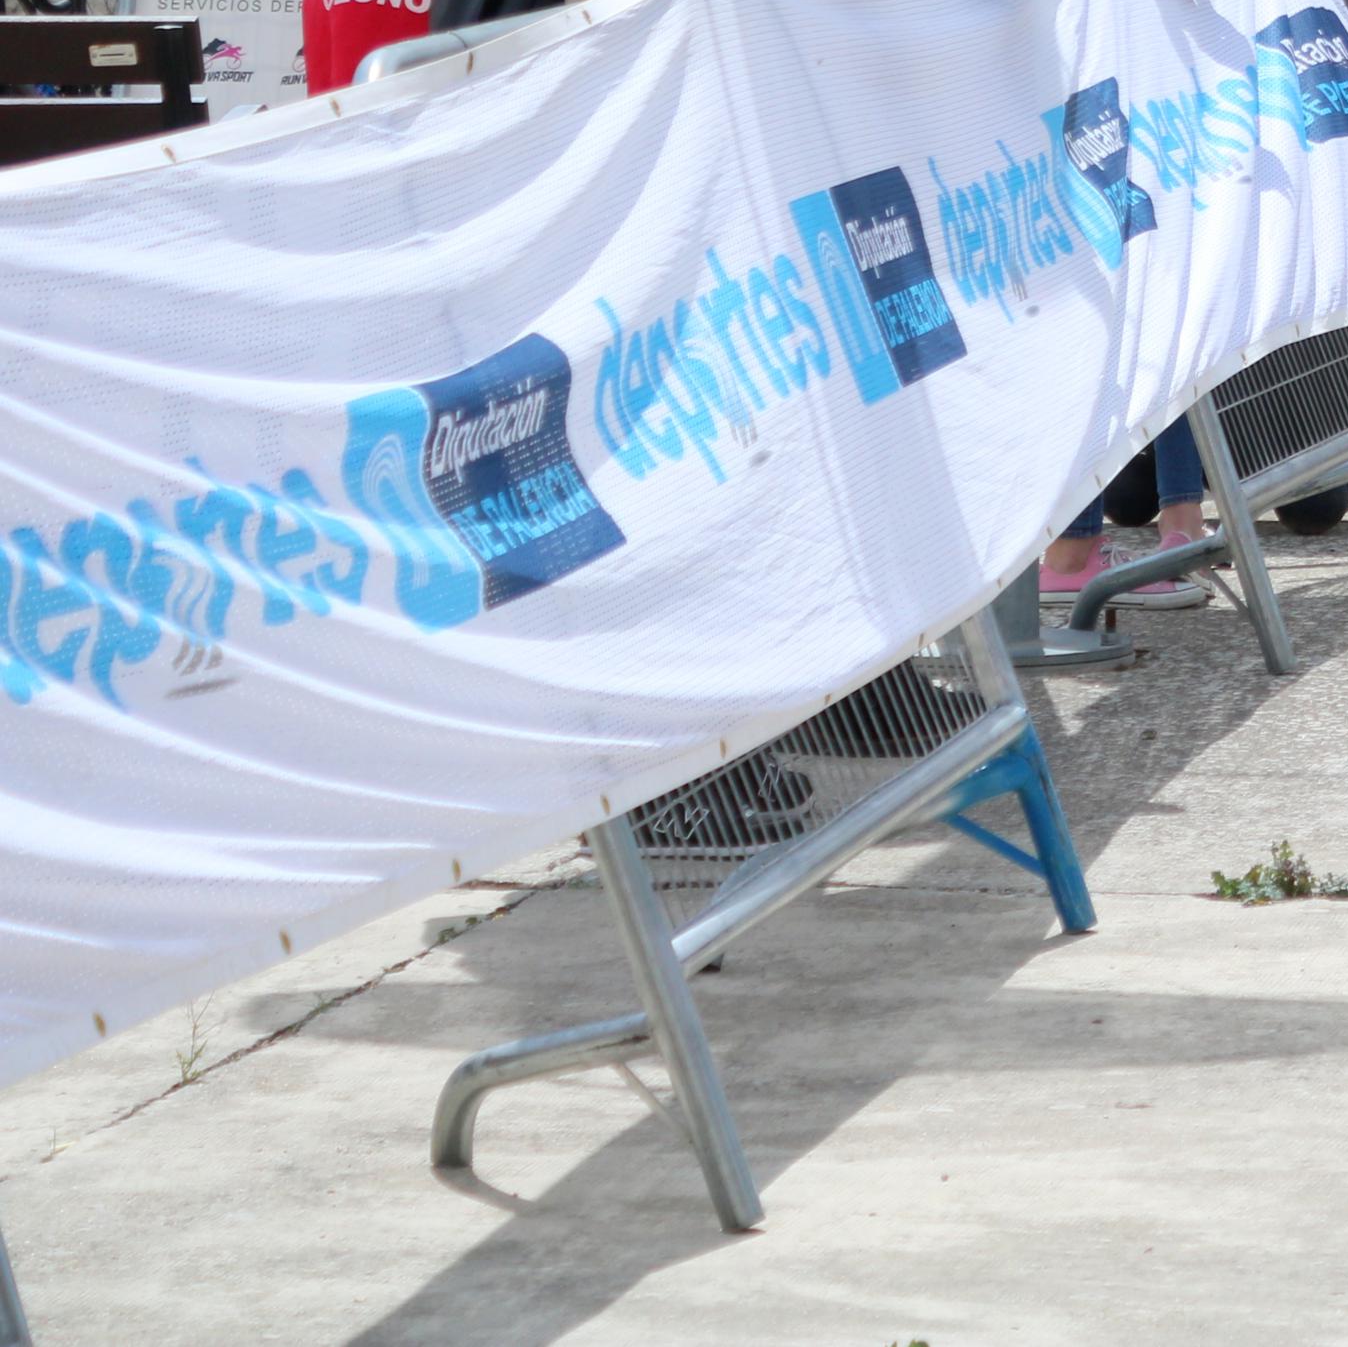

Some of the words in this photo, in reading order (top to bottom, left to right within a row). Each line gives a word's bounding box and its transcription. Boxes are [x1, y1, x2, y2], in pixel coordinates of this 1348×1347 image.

[927, 139, 1074, 325] deportes
[430, 375, 547, 485] Diputación
[594, 246, 832, 486] deportes
